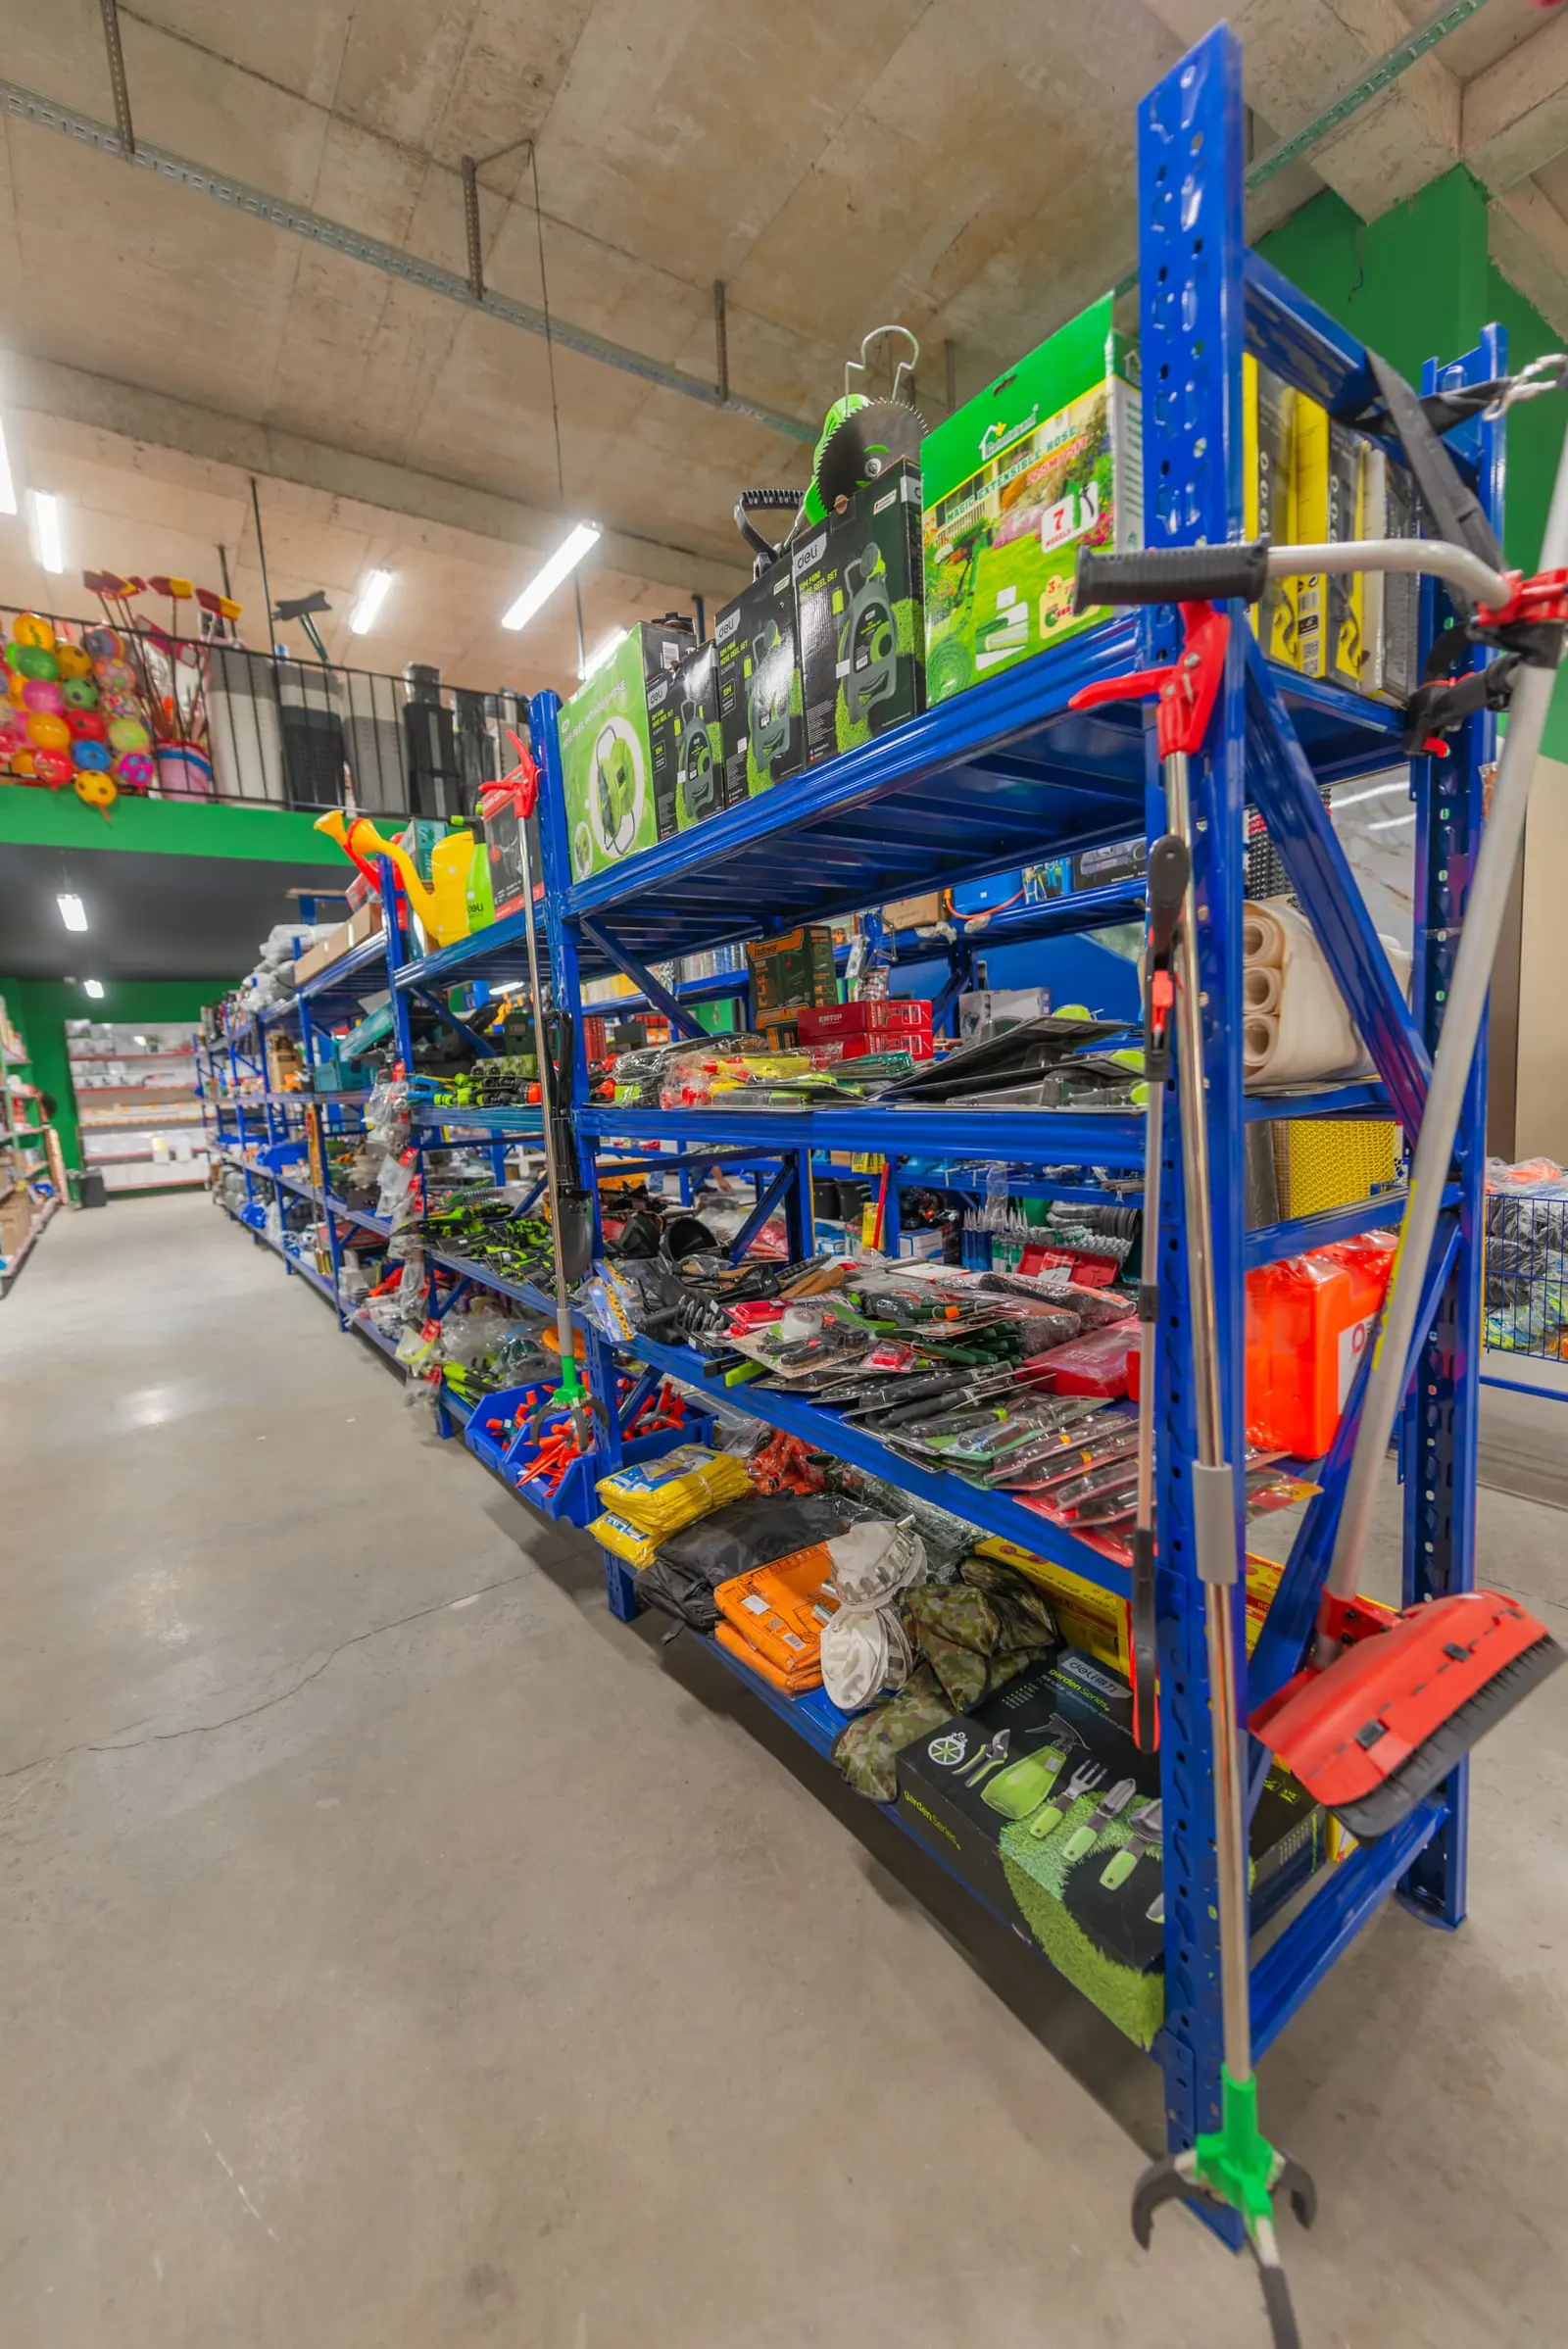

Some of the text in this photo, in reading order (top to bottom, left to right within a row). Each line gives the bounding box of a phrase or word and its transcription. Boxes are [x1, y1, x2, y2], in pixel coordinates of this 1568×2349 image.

[945, 494, 976, 522] MAGIC
[976, 450, 1042, 503] EXTENSIBLE
[1046, 425, 1077, 452] HOSE
[1053, 507, 1065, 531] 7
[797, 544, 819, 569] deli
[827, 567, 839, 582] SET
[718, 617, 734, 638] deli
[650, 687, 663, 705] deli
[1048, 1669, 1082, 1691] garden
[1069, 1662, 1097, 1681] deli
